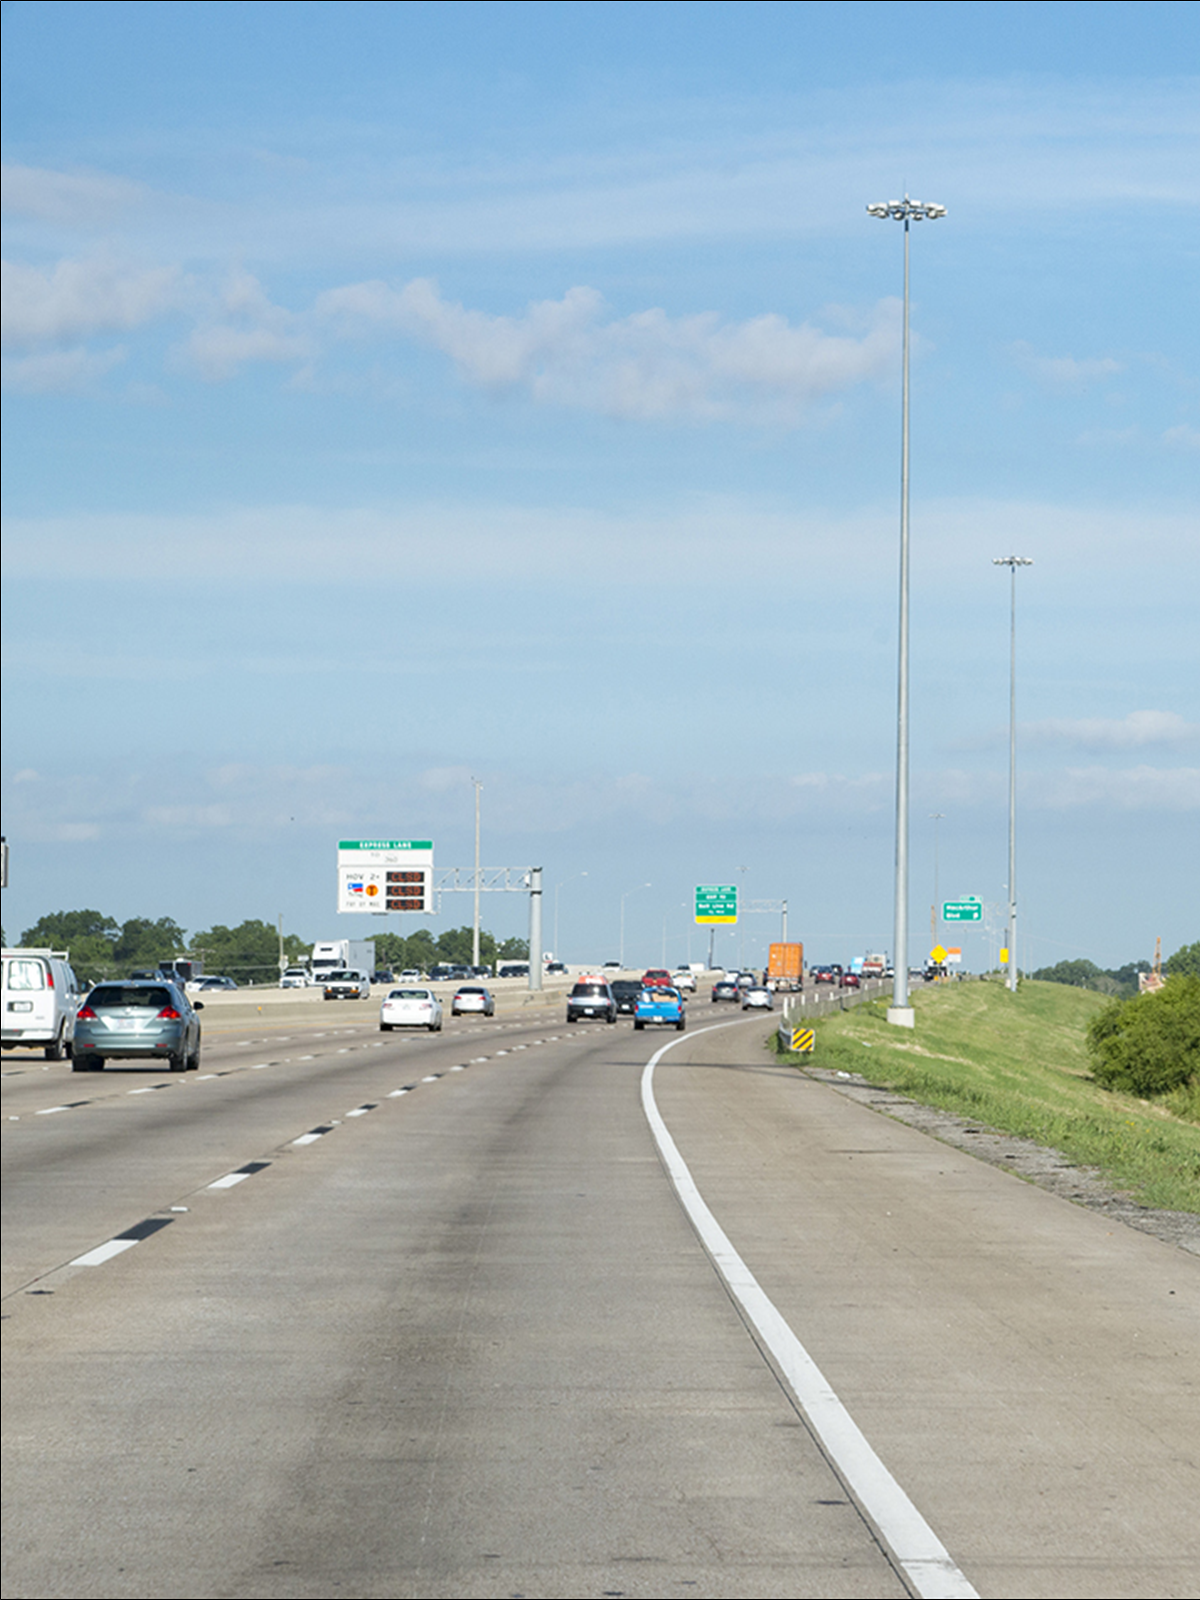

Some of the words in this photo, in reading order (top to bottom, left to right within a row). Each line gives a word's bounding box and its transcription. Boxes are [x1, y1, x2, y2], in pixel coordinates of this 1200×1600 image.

[391, 872, 421, 882] CLSD
[391, 886, 421, 896] CLSD
[391, 899, 421, 909] CLSD
